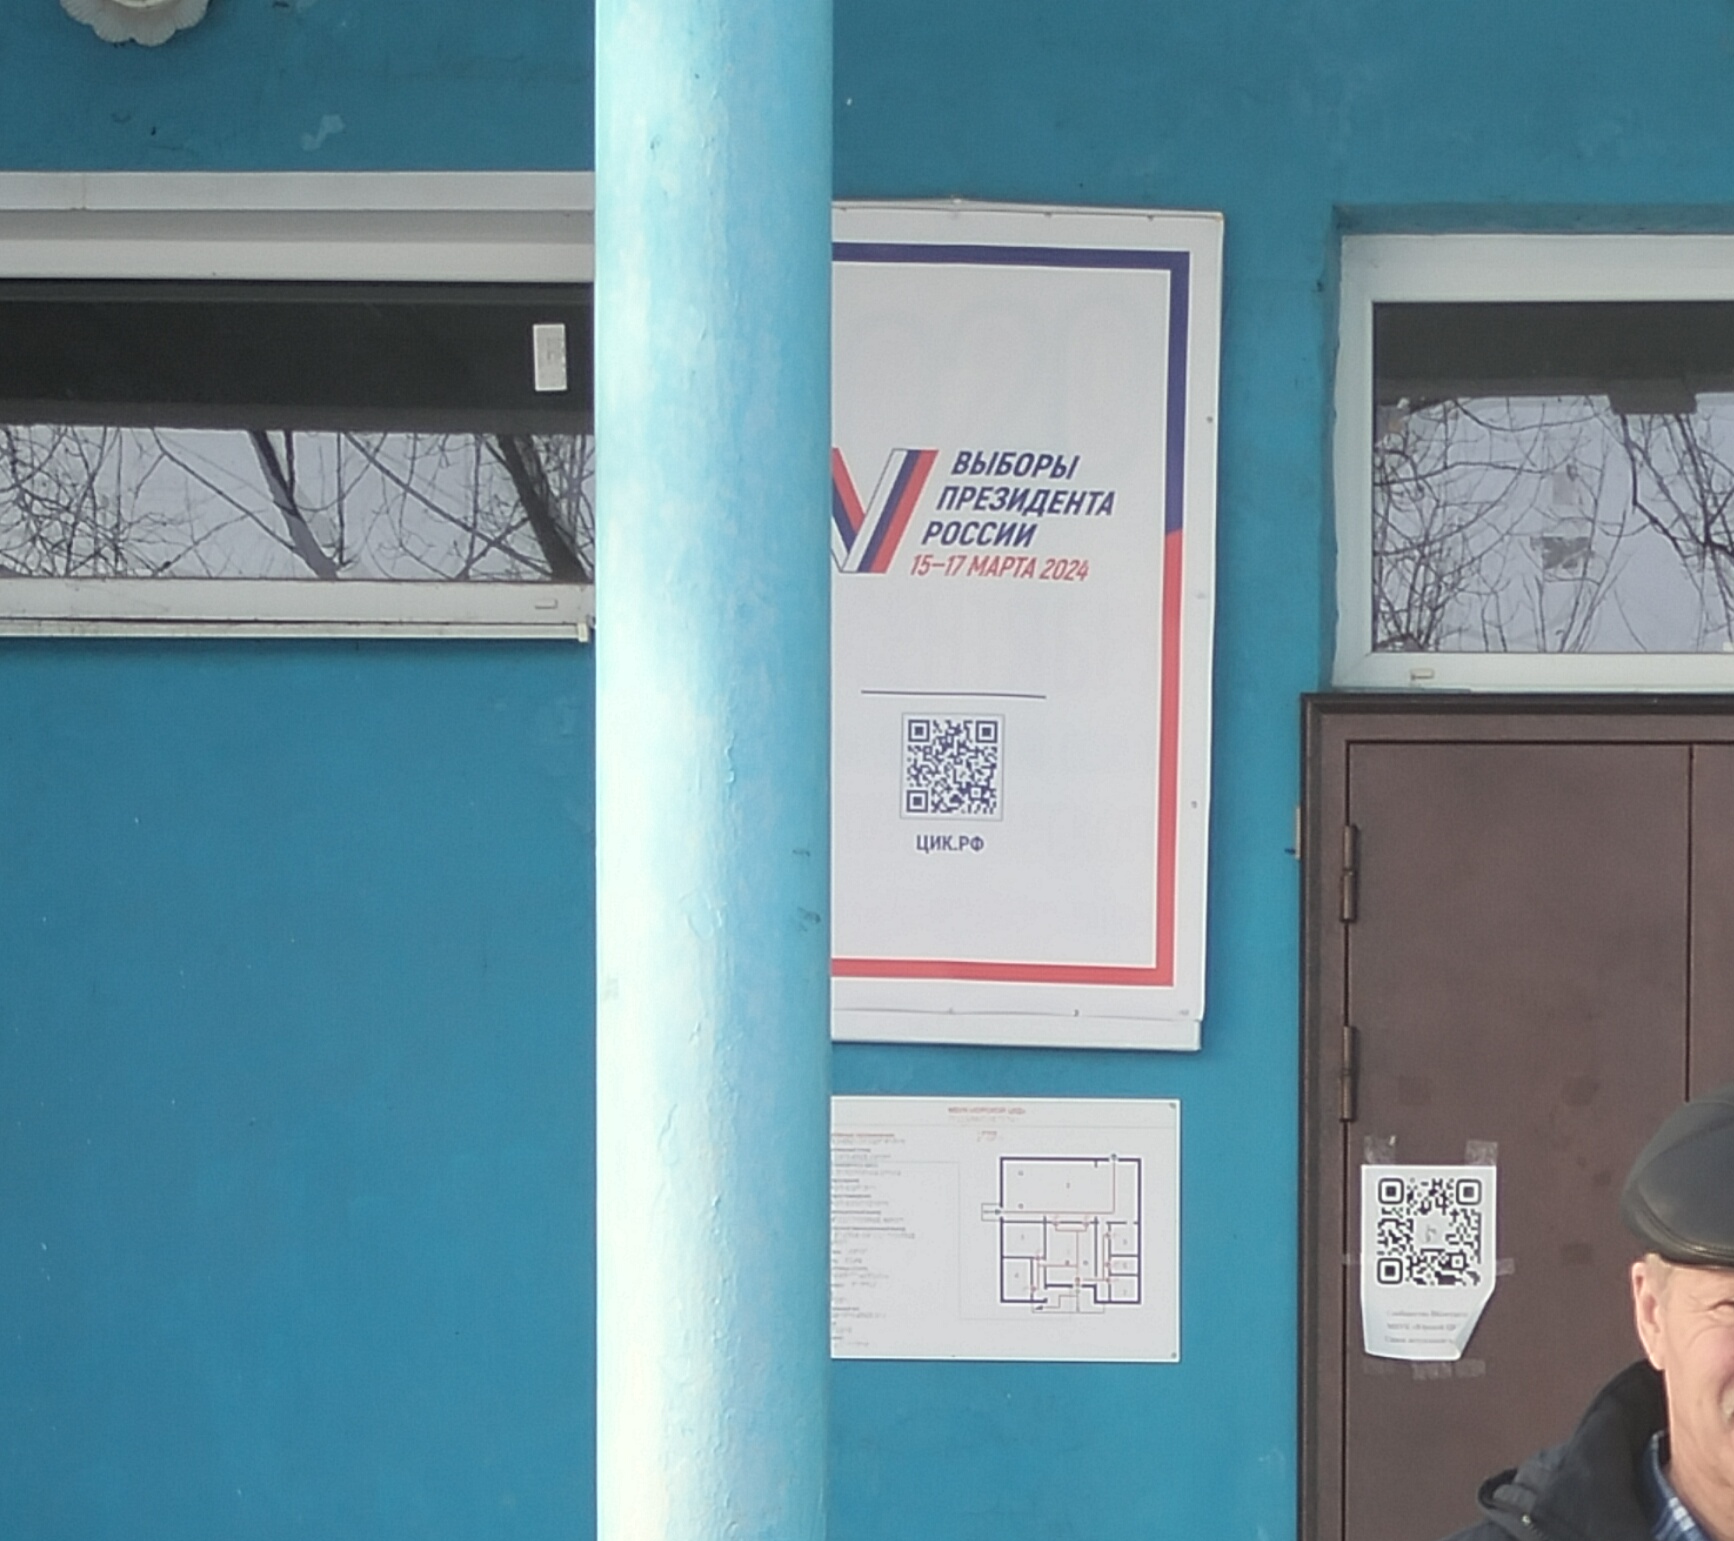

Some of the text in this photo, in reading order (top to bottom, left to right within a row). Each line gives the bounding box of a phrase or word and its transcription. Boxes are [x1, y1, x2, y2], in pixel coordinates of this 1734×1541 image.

[951, 450, 1080, 480] ВЫБОРЫ
[936, 486, 1115, 517] ПРЕЗИДЕНТА
[921, 520, 1038, 548] РОССИИ
[966, 555, 1037, 579] МАРТА
[1039, 558, 1090, 581] 2024
[915, 834, 985, 855] ЦИК.РФ
